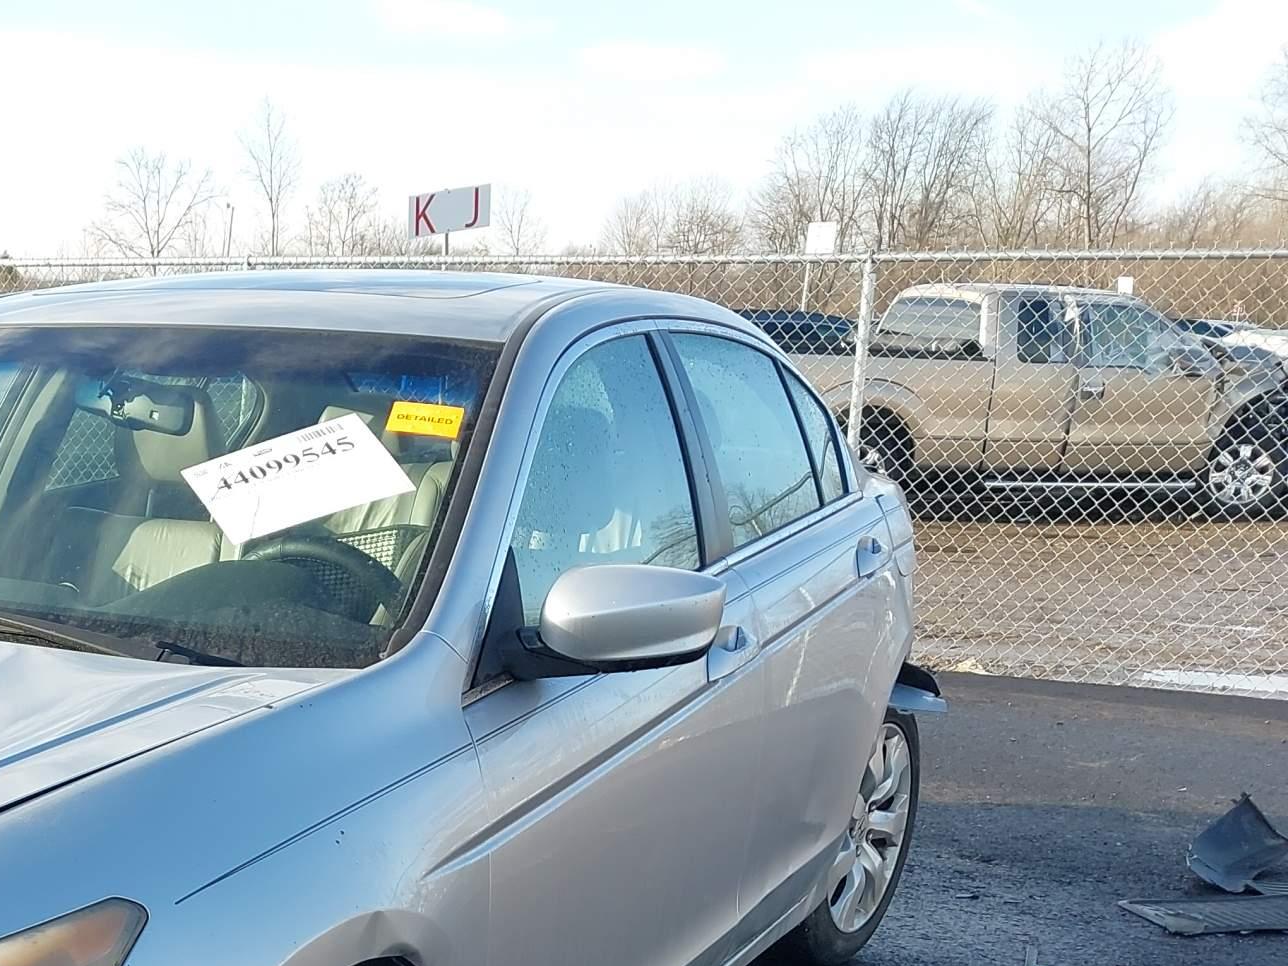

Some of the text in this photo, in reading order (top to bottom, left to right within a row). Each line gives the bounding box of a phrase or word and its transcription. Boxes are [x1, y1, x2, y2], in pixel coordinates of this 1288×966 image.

[415, 187, 479, 236] K J
[396, 413, 454, 425] DETAILED
[217, 436, 355, 490] 44099545
